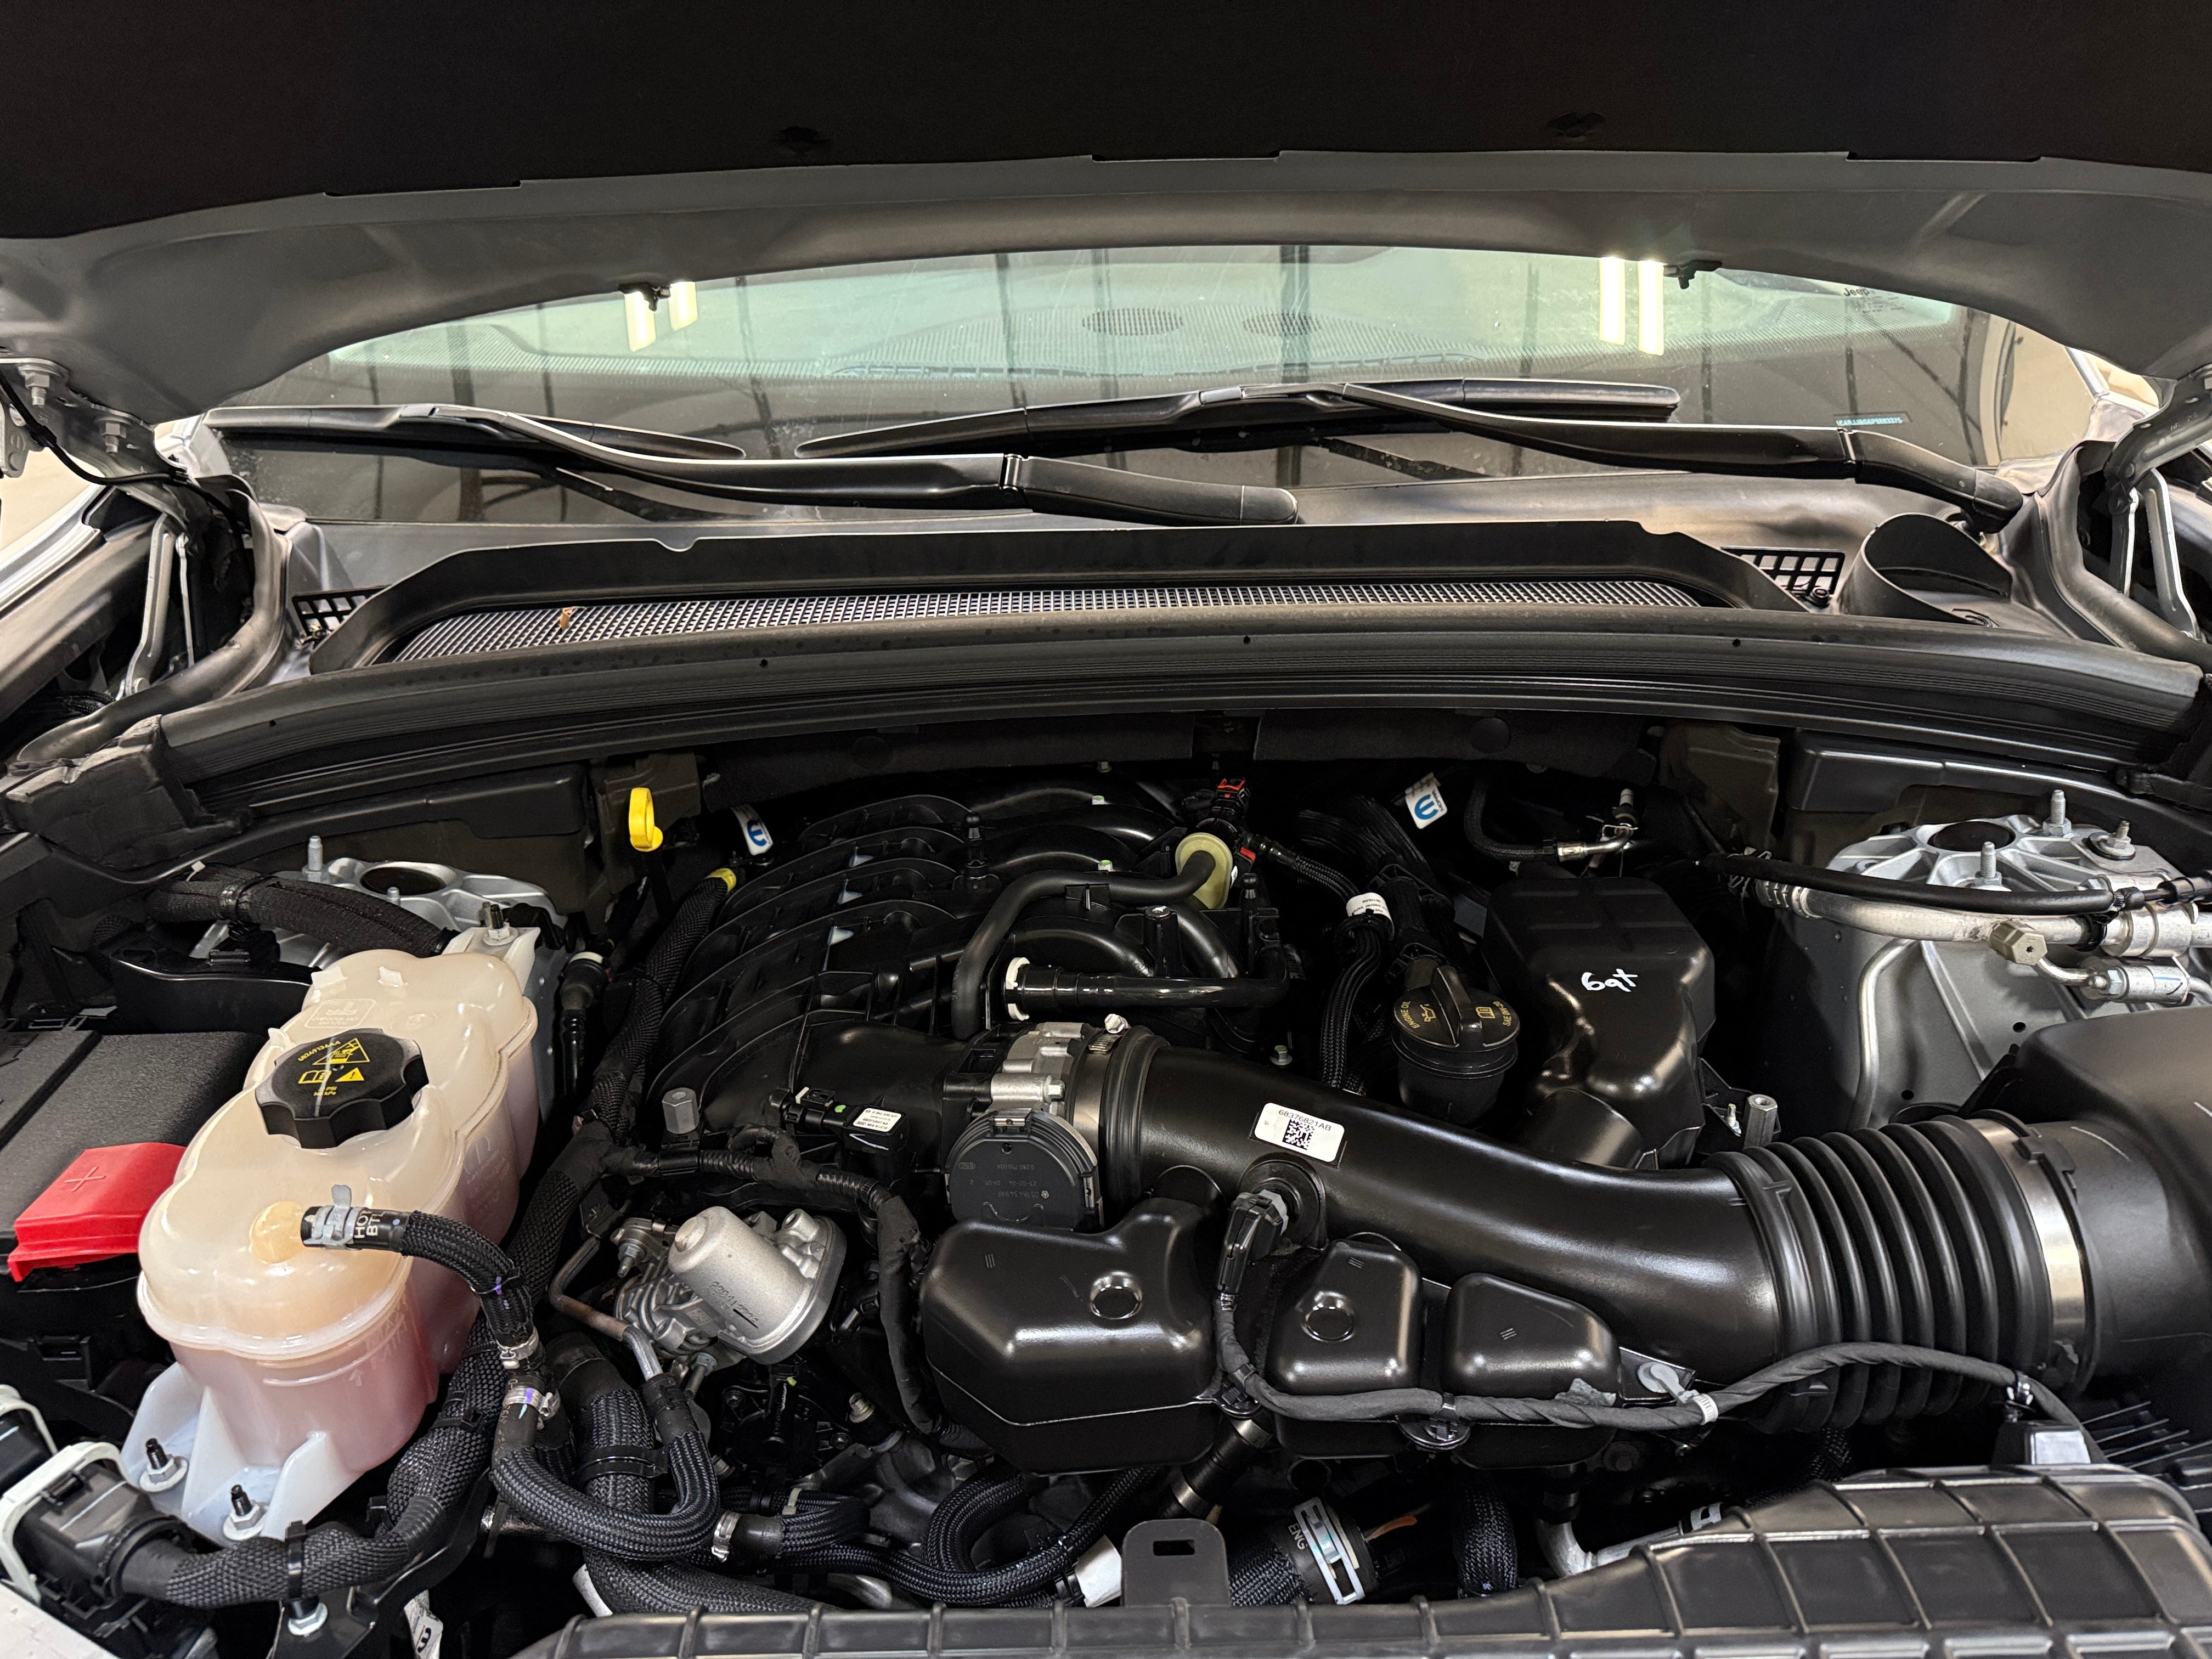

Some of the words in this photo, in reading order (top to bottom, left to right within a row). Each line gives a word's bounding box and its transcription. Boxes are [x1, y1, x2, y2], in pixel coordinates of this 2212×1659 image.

[1843, 287, 1870, 296] Jeep
[1401, 1001, 1411, 1009] OIL
[1492, 1001, 1510, 1015] 0W-20
[1400, 1009, 1421, 1029] ENGINE
[1502, 1015, 1512, 1026] SAE
[1278, 1109, 1331, 1131] 68376821AB
[354, 1210, 373, 1239] HOT
